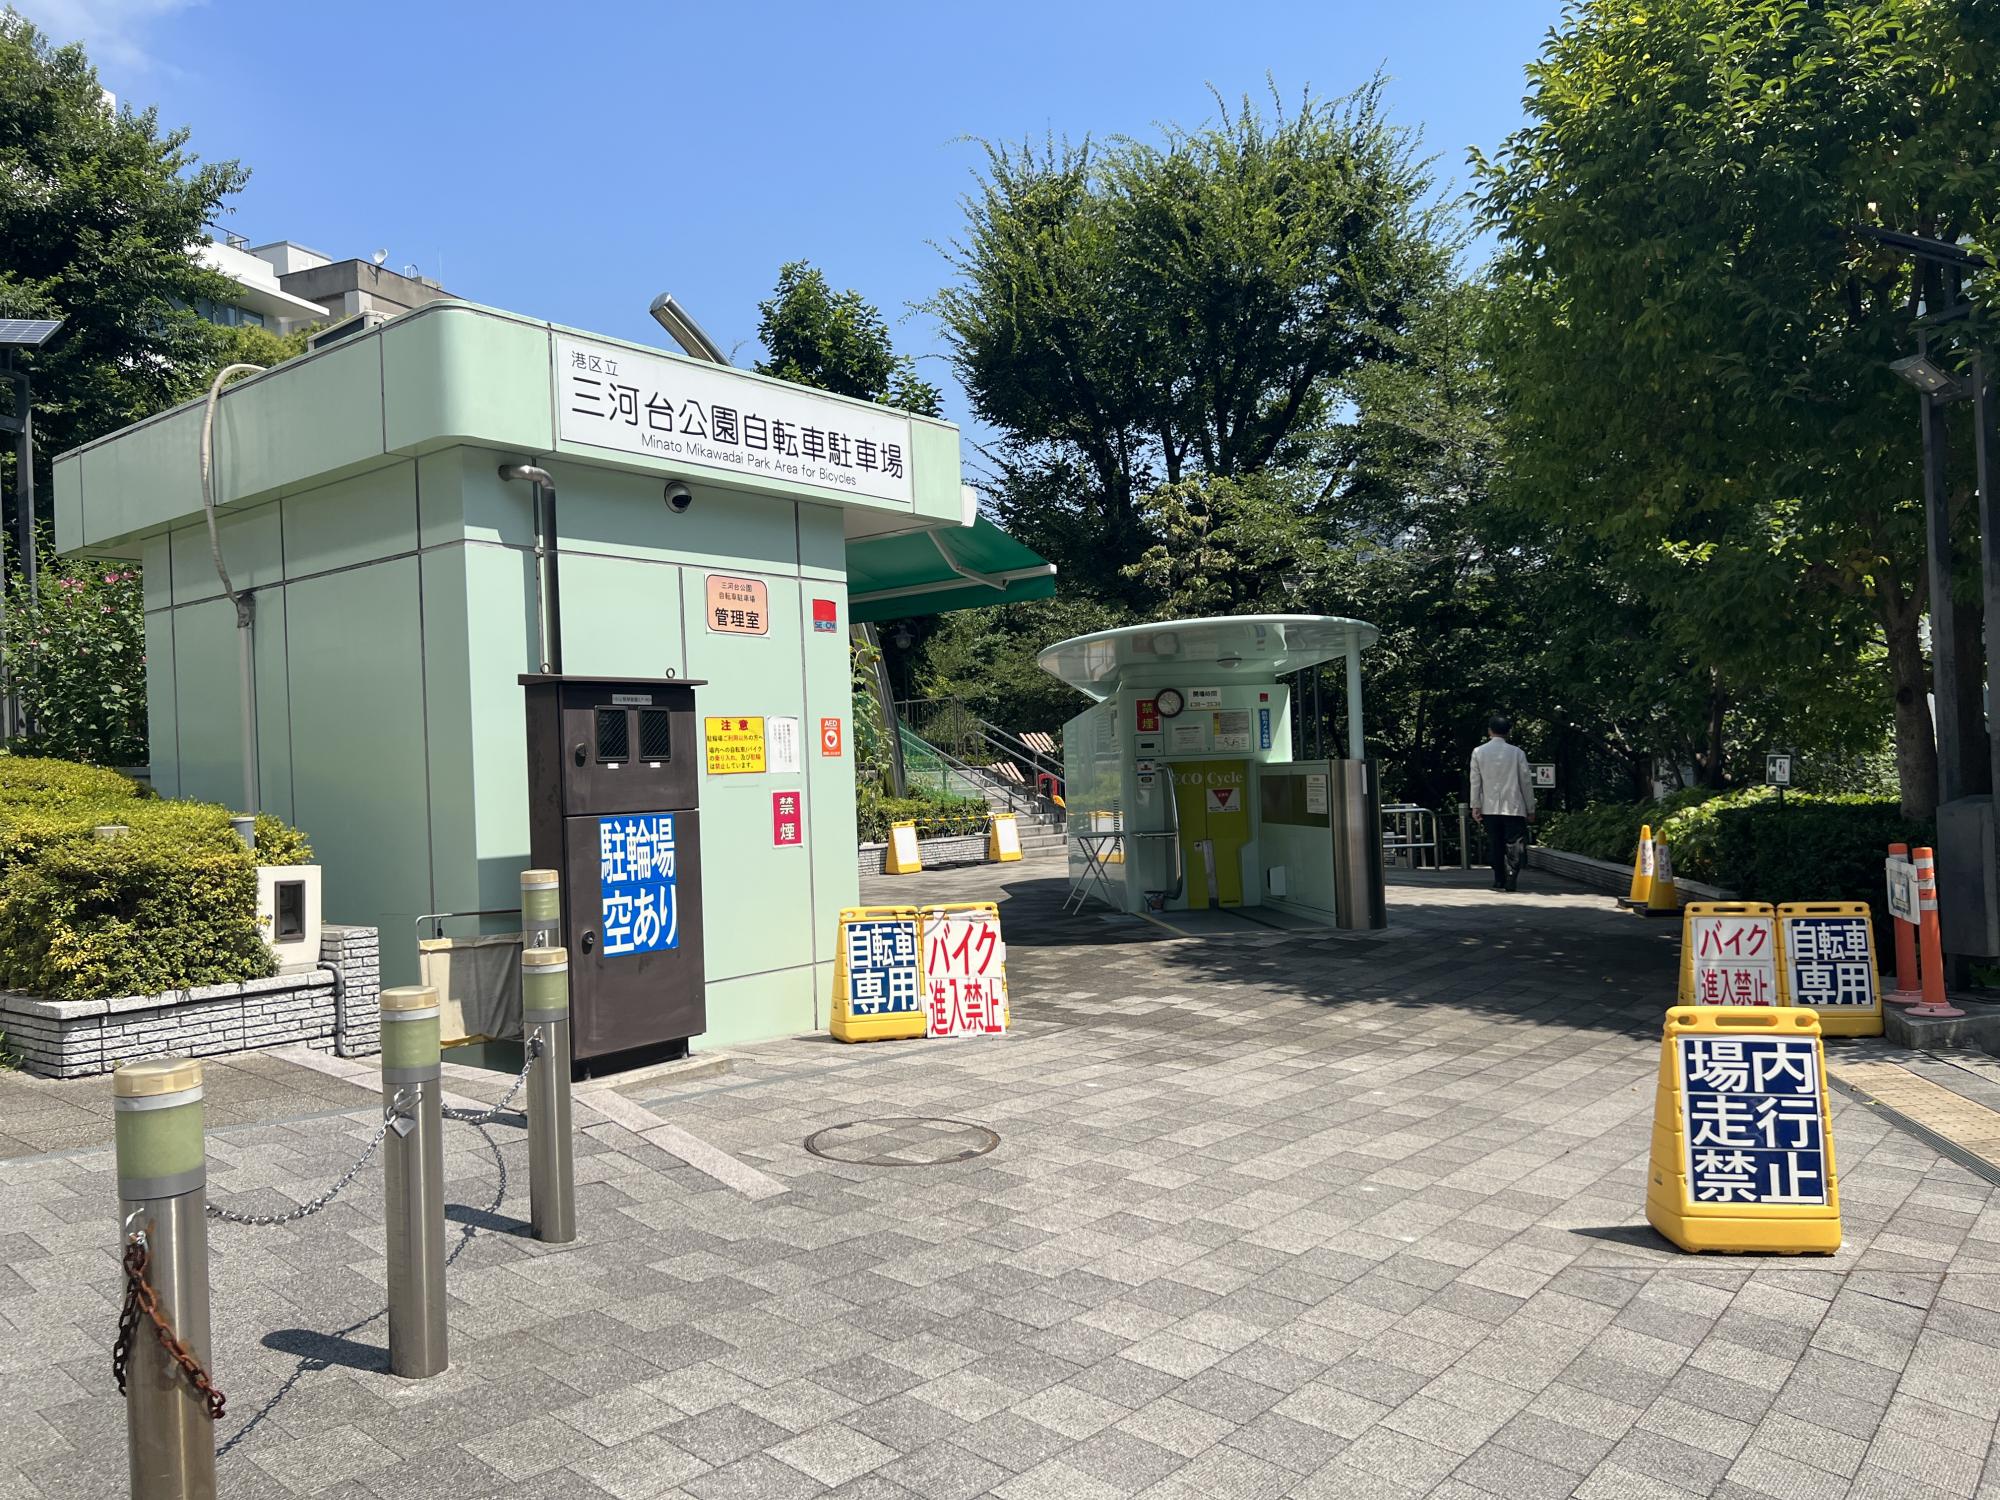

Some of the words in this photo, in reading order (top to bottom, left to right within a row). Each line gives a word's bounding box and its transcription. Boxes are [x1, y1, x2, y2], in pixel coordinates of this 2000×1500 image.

[572, 350, 619, 377] 港区立
[572, 376, 903, 479] 三河台公園自転車駐車場
[641, 433, 682, 453] Minato
[686, 442, 744, 465] Mikawadai
[747, 454, 771, 470] Park
[774, 460, 798, 475] Area
[801, 464, 816, 478] for
[819, 467, 857, 486] Bicycles
[718, 591, 756, 603] 自転車駐車場
[721, 582, 753, 593] 三河台公園
[714, 607, 760, 630] 管理室
[815, 621, 836, 629] SECOM
[720, 719, 749, 731] 注意
[824, 719, 838, 727] AED
[1206, 771, 1244, 786] Cycle
[780, 796, 796, 840] 禁煙
[600, 817, 676, 884] 駐輪場
[603, 884, 678, 955] 空あり
[1700, 919, 1768, 957] バイク
[1791, 920, 1870, 961] 自転車
[848, 923, 915, 969] 自転車
[928, 921, 997, 977] バイク
[852, 967, 918, 1014] 専用
[1701, 968, 1770, 1006] 進入禁止
[1796, 960, 1872, 1005] 専用
[929, 978, 1002, 1035] 進入禁止
[1687, 1040, 1815, 1094] 場内
[1691, 1095, 1818, 1148] 走行
[1694, 1149, 1823, 1204] 禁止
